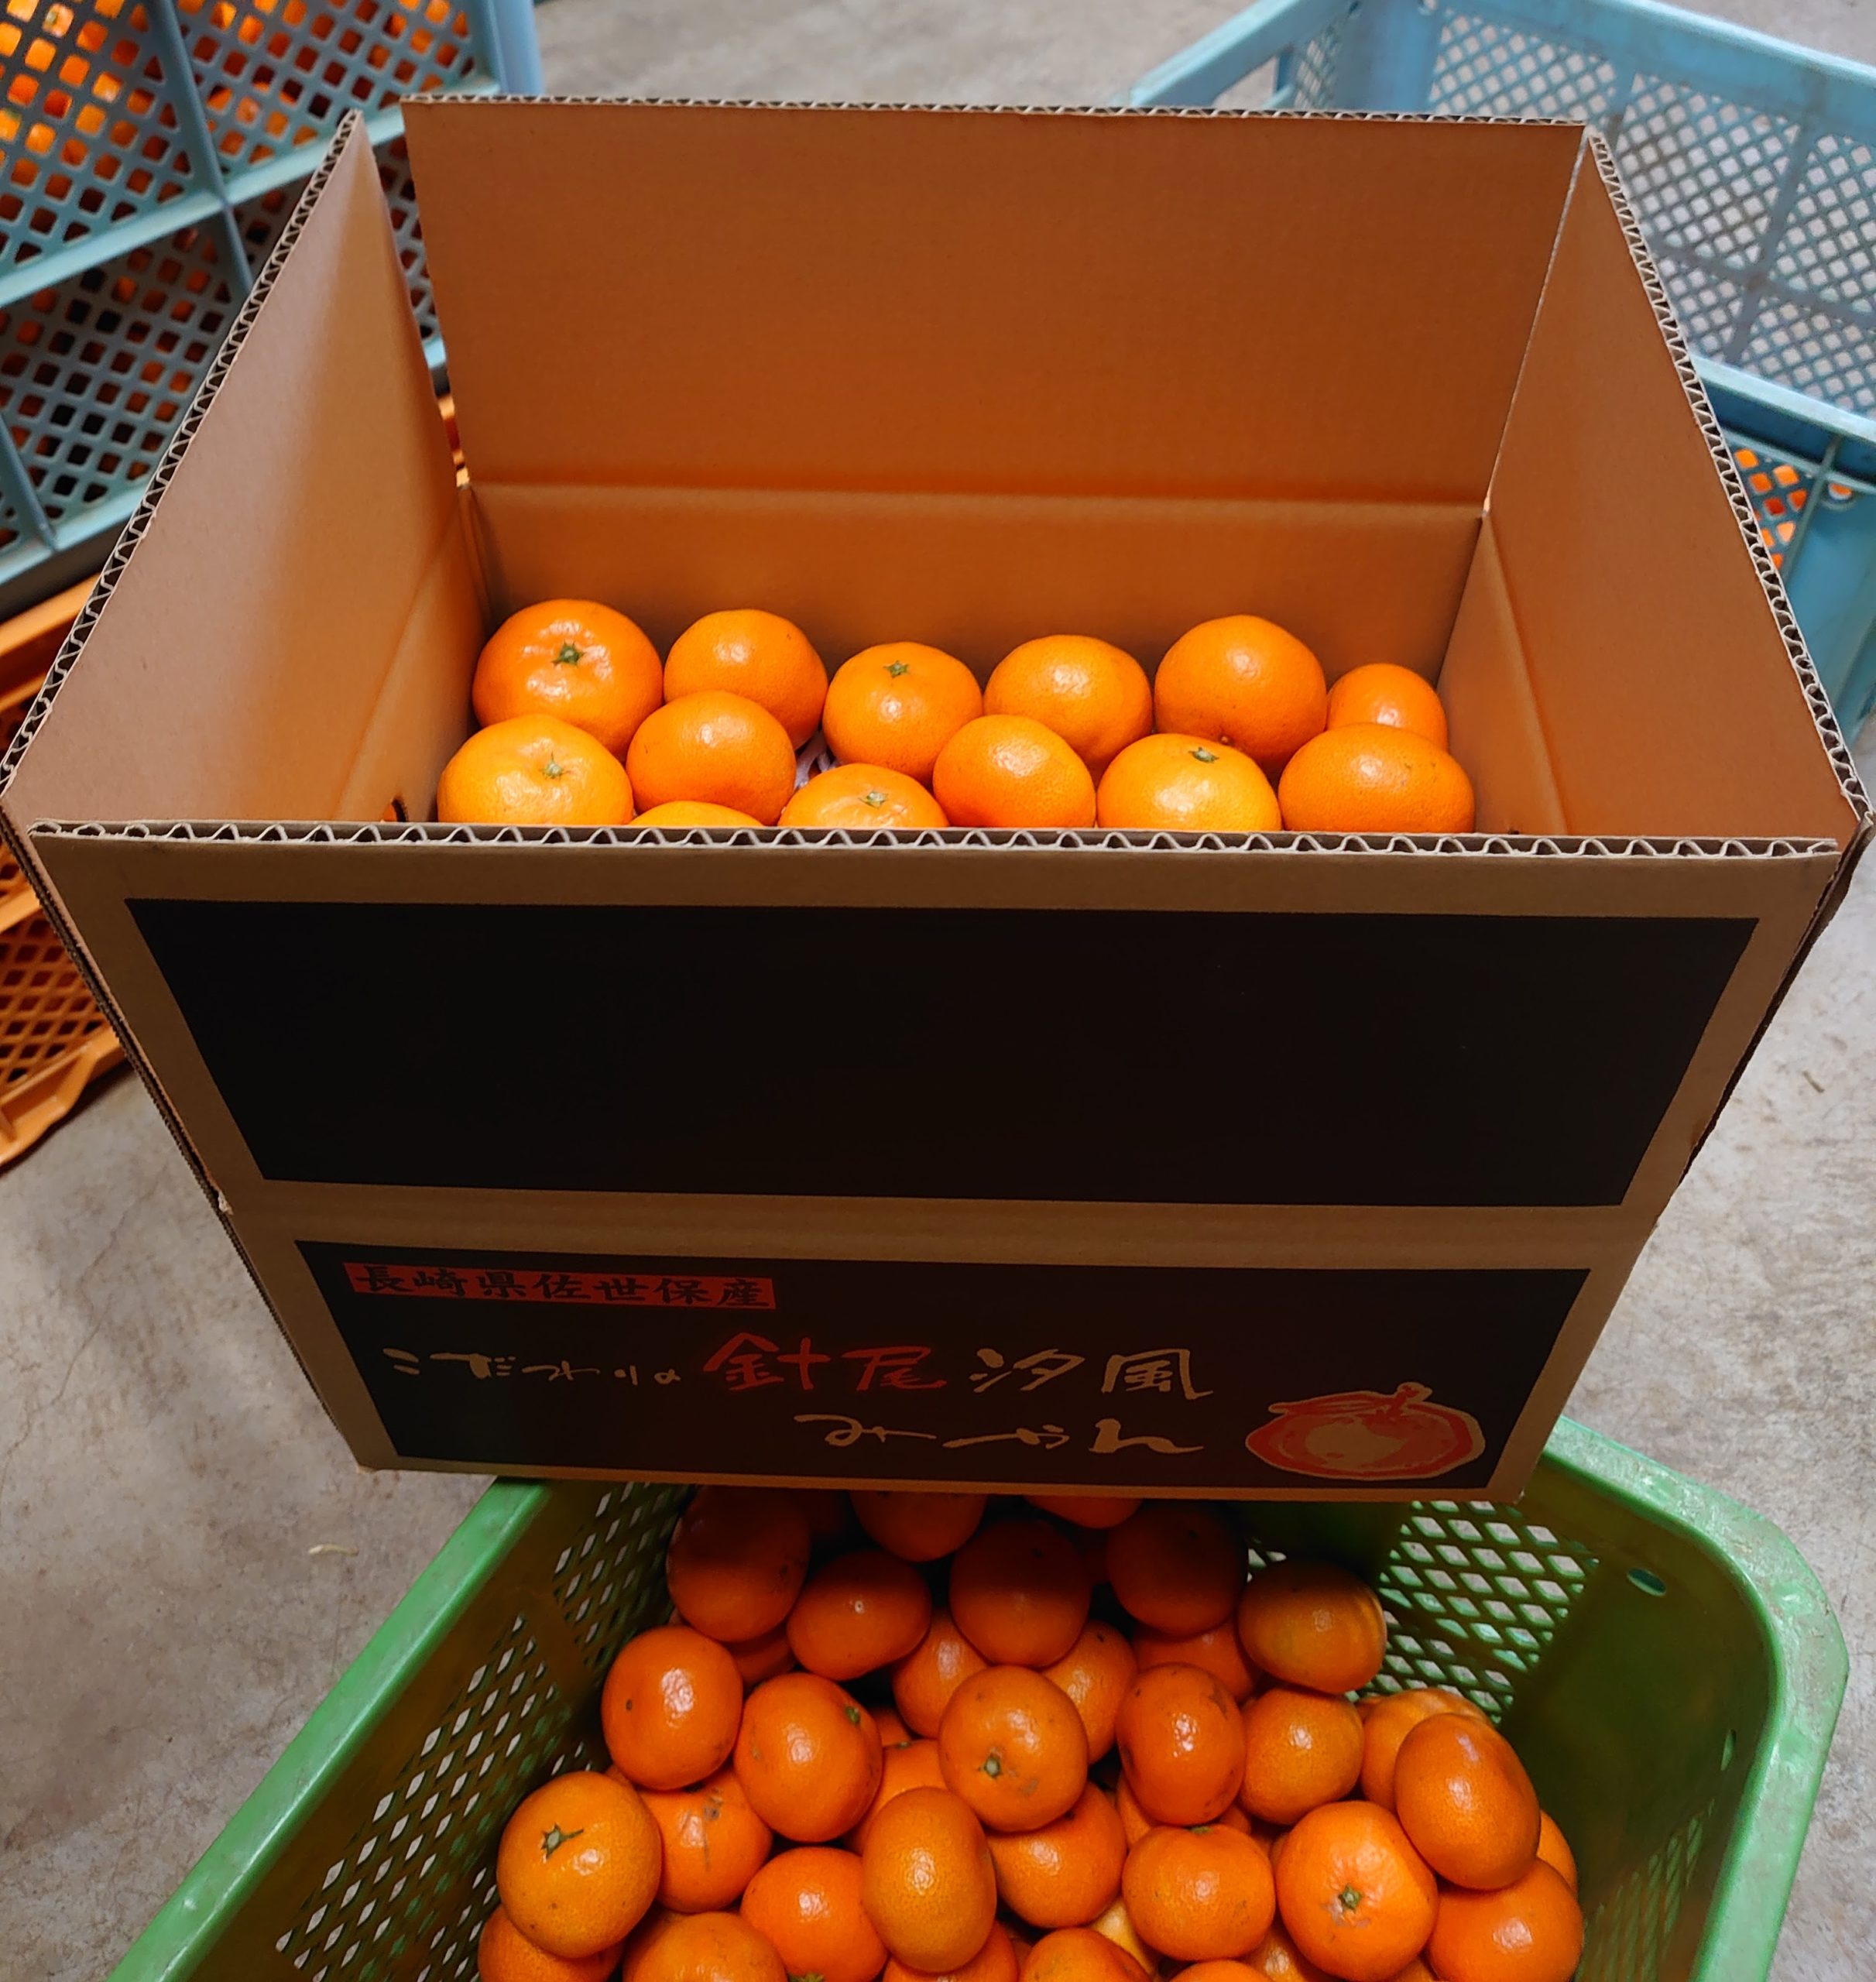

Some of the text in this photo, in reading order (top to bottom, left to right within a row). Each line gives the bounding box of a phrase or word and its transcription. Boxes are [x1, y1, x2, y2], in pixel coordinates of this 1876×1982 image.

[355, 1265, 770, 1307] 長崎県佐世保産
[794, 1414, 1205, 1455] みかん
